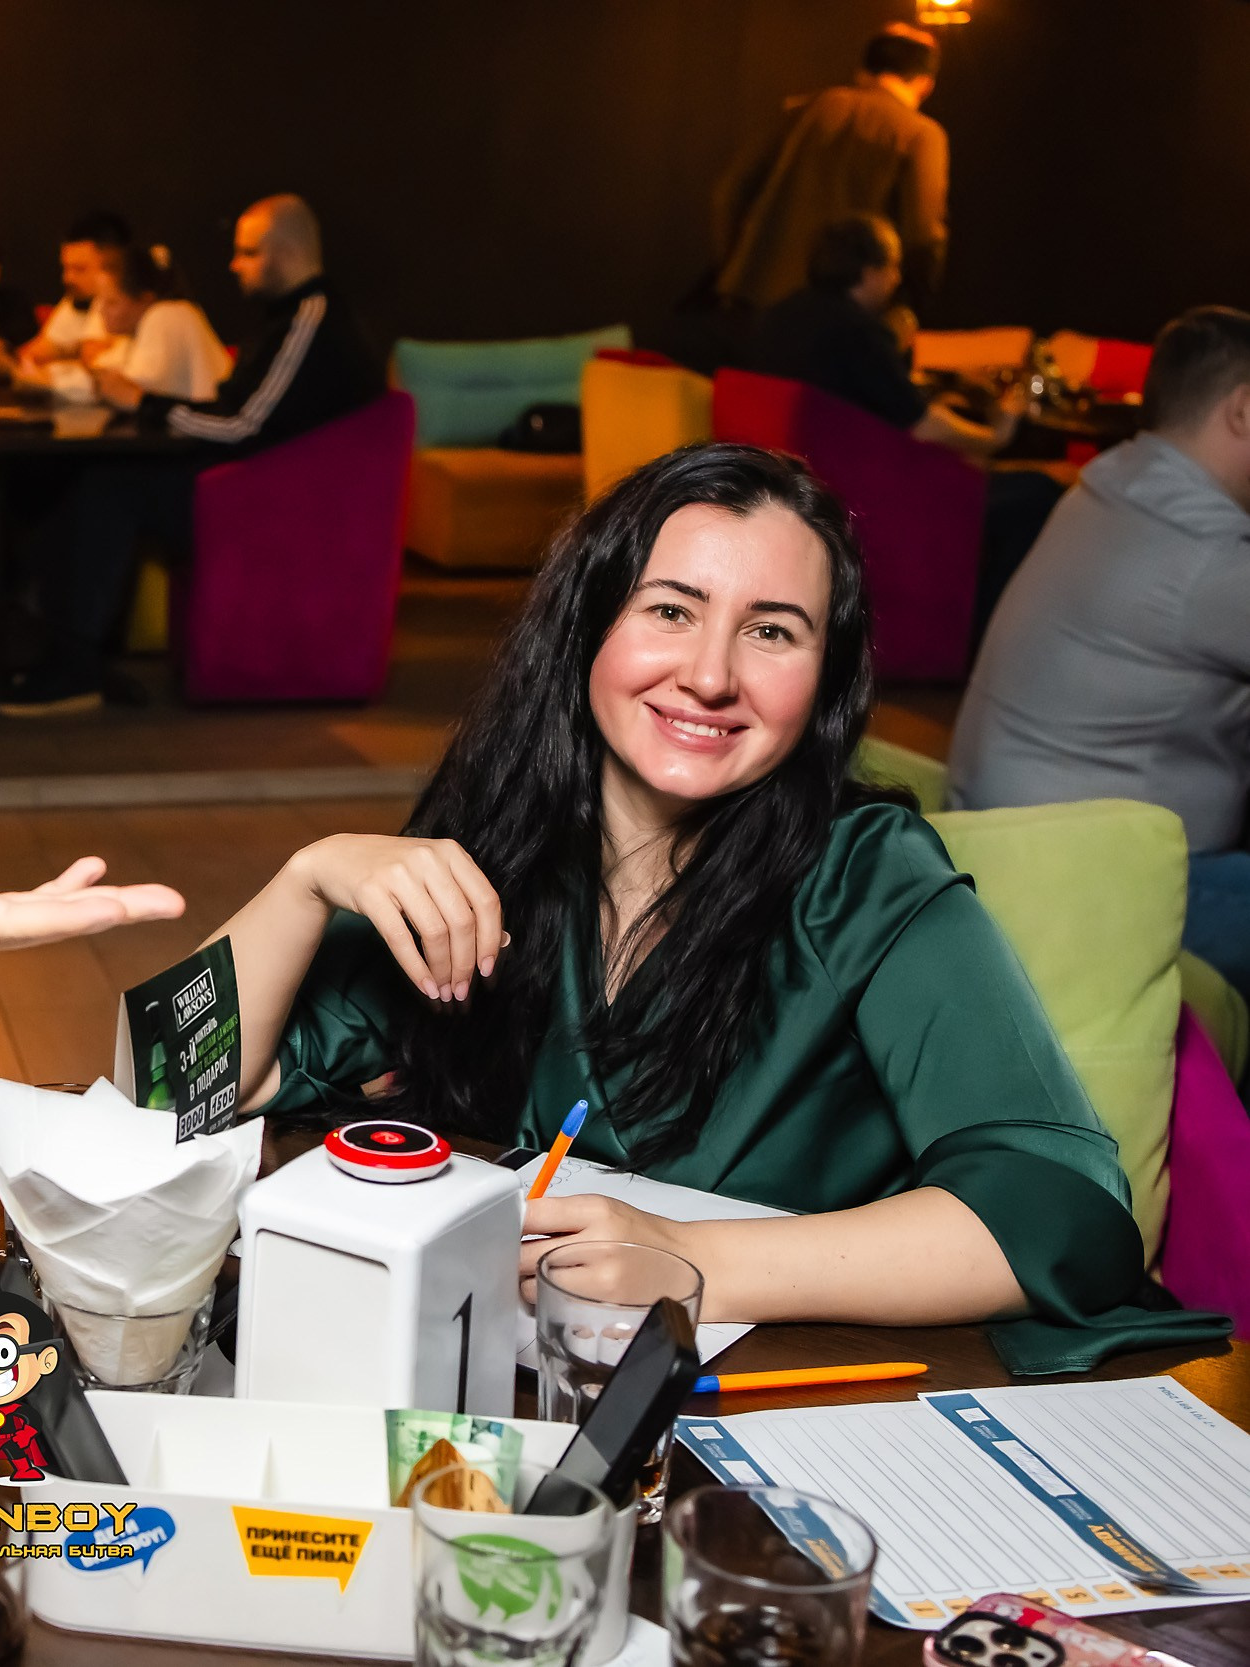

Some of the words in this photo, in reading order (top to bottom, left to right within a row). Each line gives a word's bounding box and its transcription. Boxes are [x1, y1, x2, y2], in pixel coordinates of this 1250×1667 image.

[177, 977, 208, 1009] WILLIAM
[190, 1084, 195, 1101] В
[197, 1050, 230, 1095] ПОДАРОК
[211, 1087, 234, 1114] 1500
[180, 1105, 204, 1136] 3000
[247, 1526, 360, 1547] ПРИНЕСИТЕ
[251, 1544, 291, 1560] ЕЩЁ
[297, 1548, 355, 1564] ПИВА!
